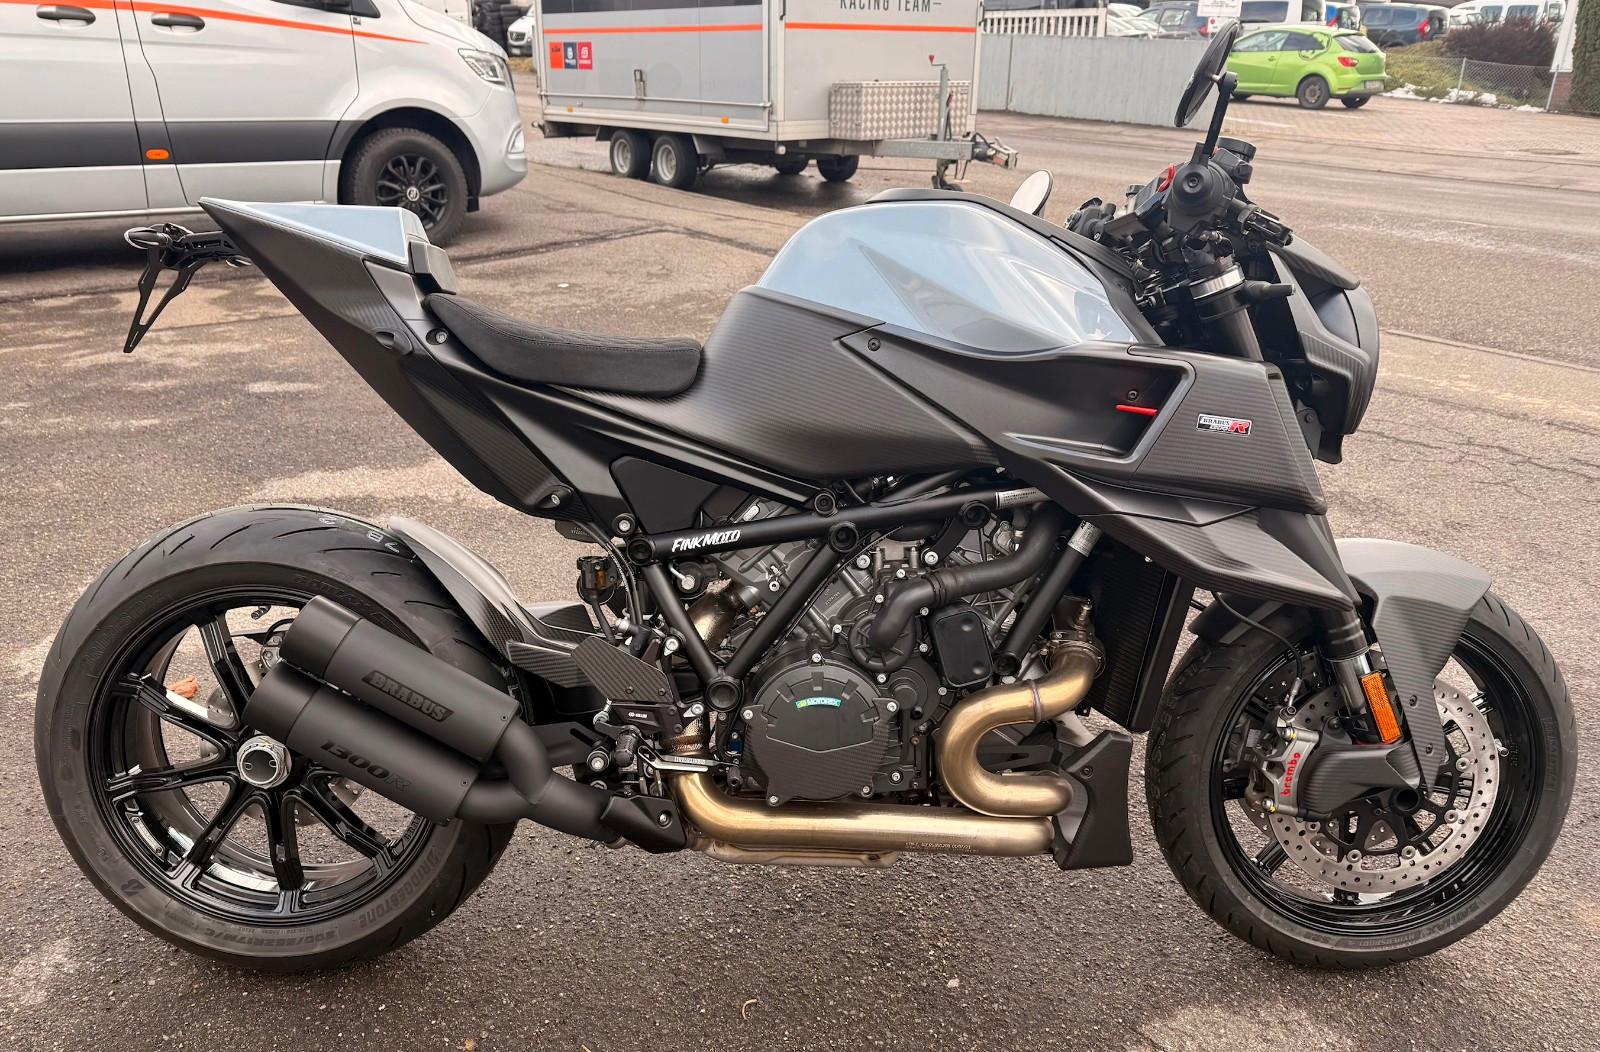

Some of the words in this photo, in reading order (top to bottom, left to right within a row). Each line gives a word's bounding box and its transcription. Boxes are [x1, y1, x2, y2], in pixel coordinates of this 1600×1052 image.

[840, 0, 889, 11] RACING
[897, 0, 931, 12] TEAM
[369, 672, 447, 721] BRABUS
[1280, 752, 1301, 797] brembo
